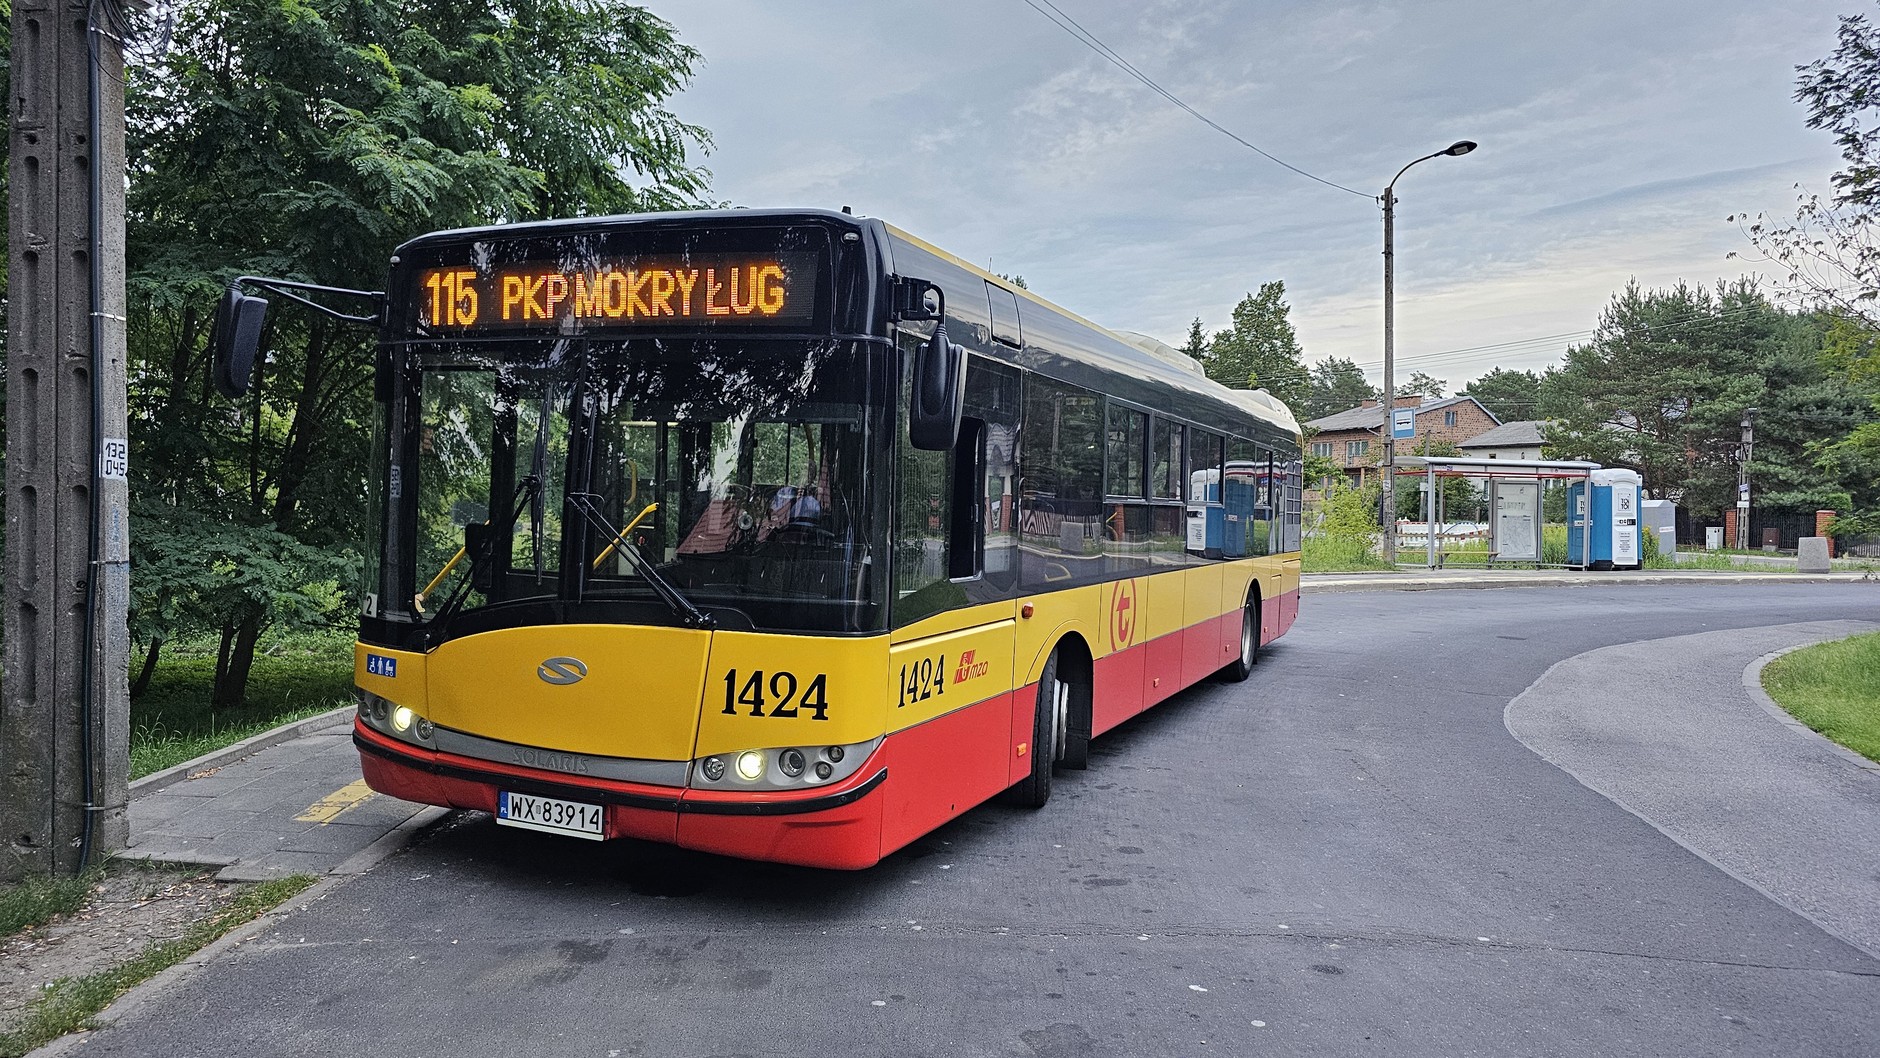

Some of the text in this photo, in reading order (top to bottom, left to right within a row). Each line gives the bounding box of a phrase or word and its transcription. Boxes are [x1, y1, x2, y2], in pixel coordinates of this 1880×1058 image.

[427, 265, 785, 326] 115 PKP MOKRY ŁUG
[105, 442, 125, 459] 132
[105, 459, 125, 476] 045
[366, 595, 372, 615] 2
[897, 654, 945, 708] 1424
[721, 668, 829, 721] 1424
[512, 747, 589, 773] SOLARIS
[501, 806, 508, 814] PL
[511, 795, 600, 831] WX 83914
